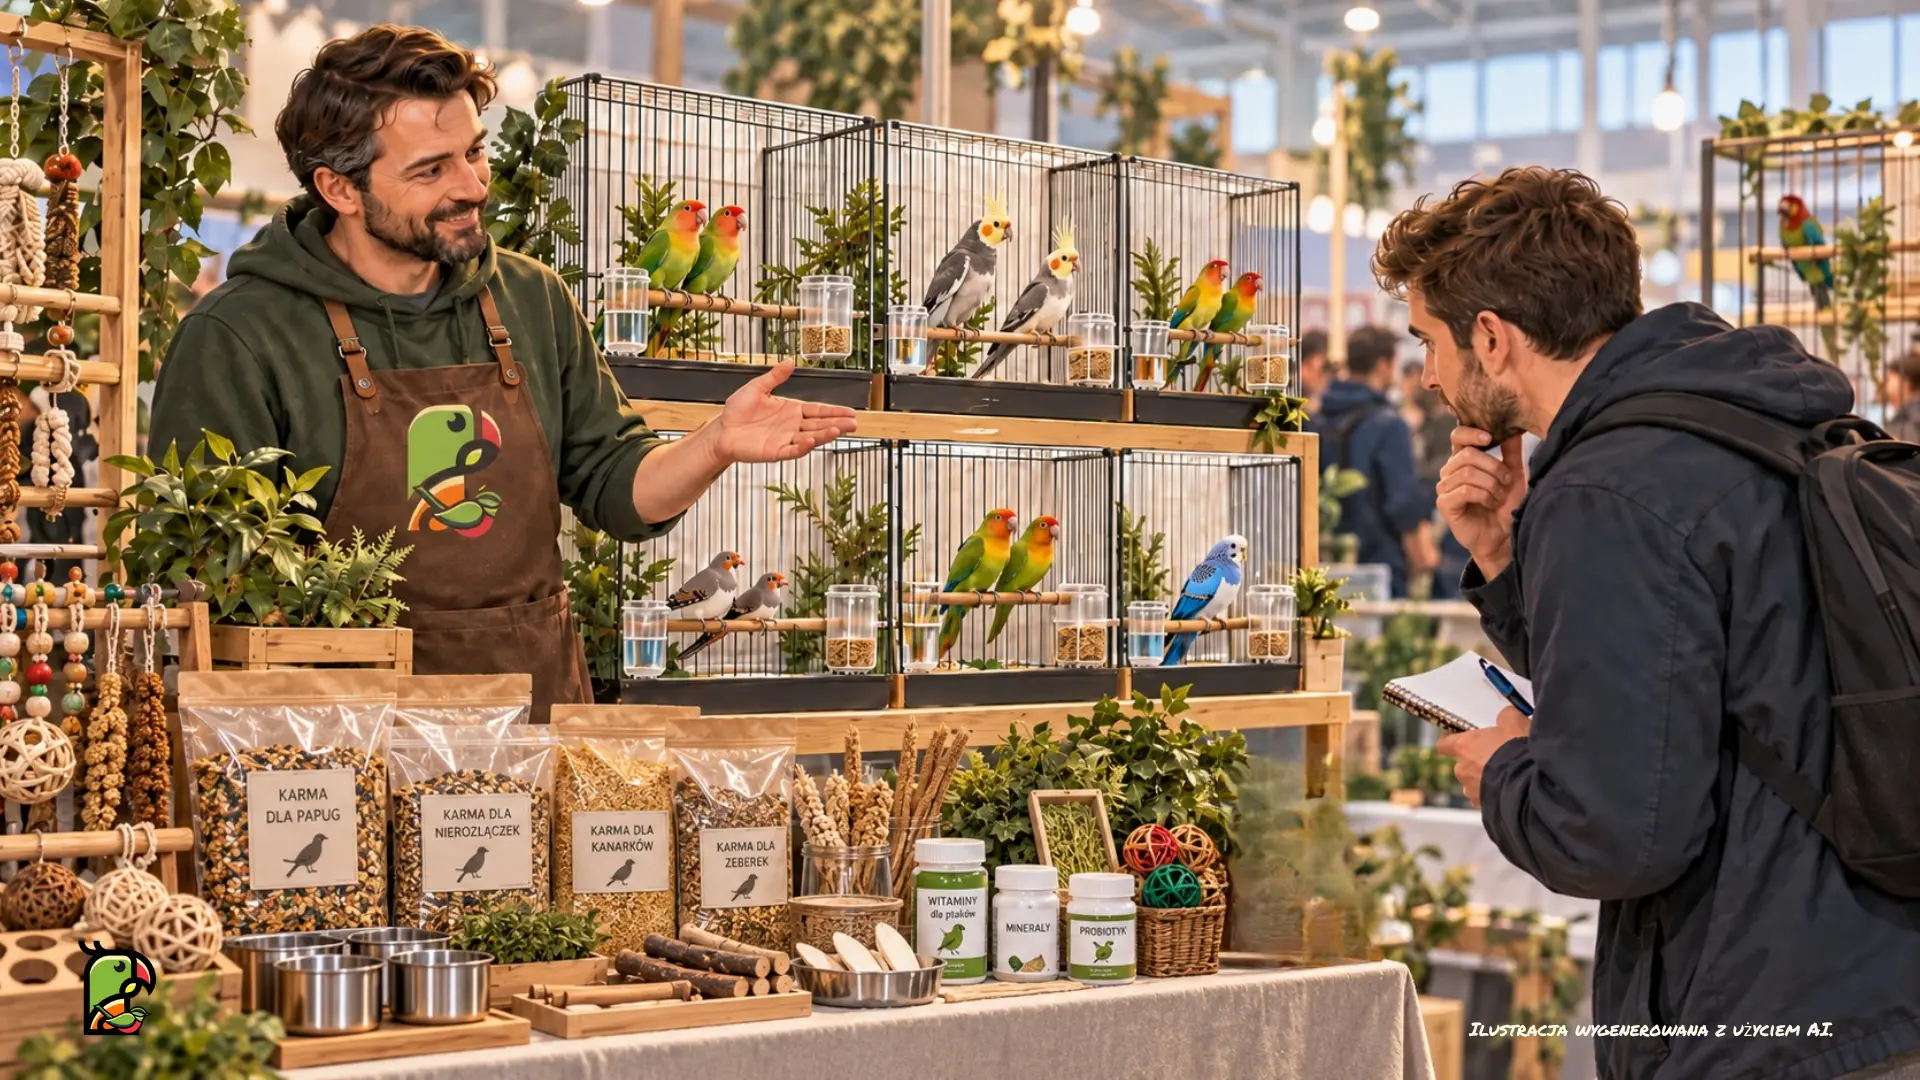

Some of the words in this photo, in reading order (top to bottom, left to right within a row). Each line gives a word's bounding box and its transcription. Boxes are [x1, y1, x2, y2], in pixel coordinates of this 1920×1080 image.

[279, 788, 328, 802] KARMA
[266, 810, 292, 824] DLA
[297, 808, 341, 823] PAPUG
[443, 808, 486, 820] KARMA
[489, 807, 512, 819] DLA
[590, 825, 630, 836] KARMA
[633, 825, 654, 836] DLA
[591, 838, 654, 852] KANARKÓW
[716, 841, 754, 852] KARMA
[756, 840, 775, 851] DLA
[724, 856, 769, 868] ZEBEREK
[927, 896, 978, 906] WITAMINY
[930, 909, 943, 919] dla
[945, 909, 976, 921] ptaków
[1079, 926, 1127, 936] PROBIOTYK
